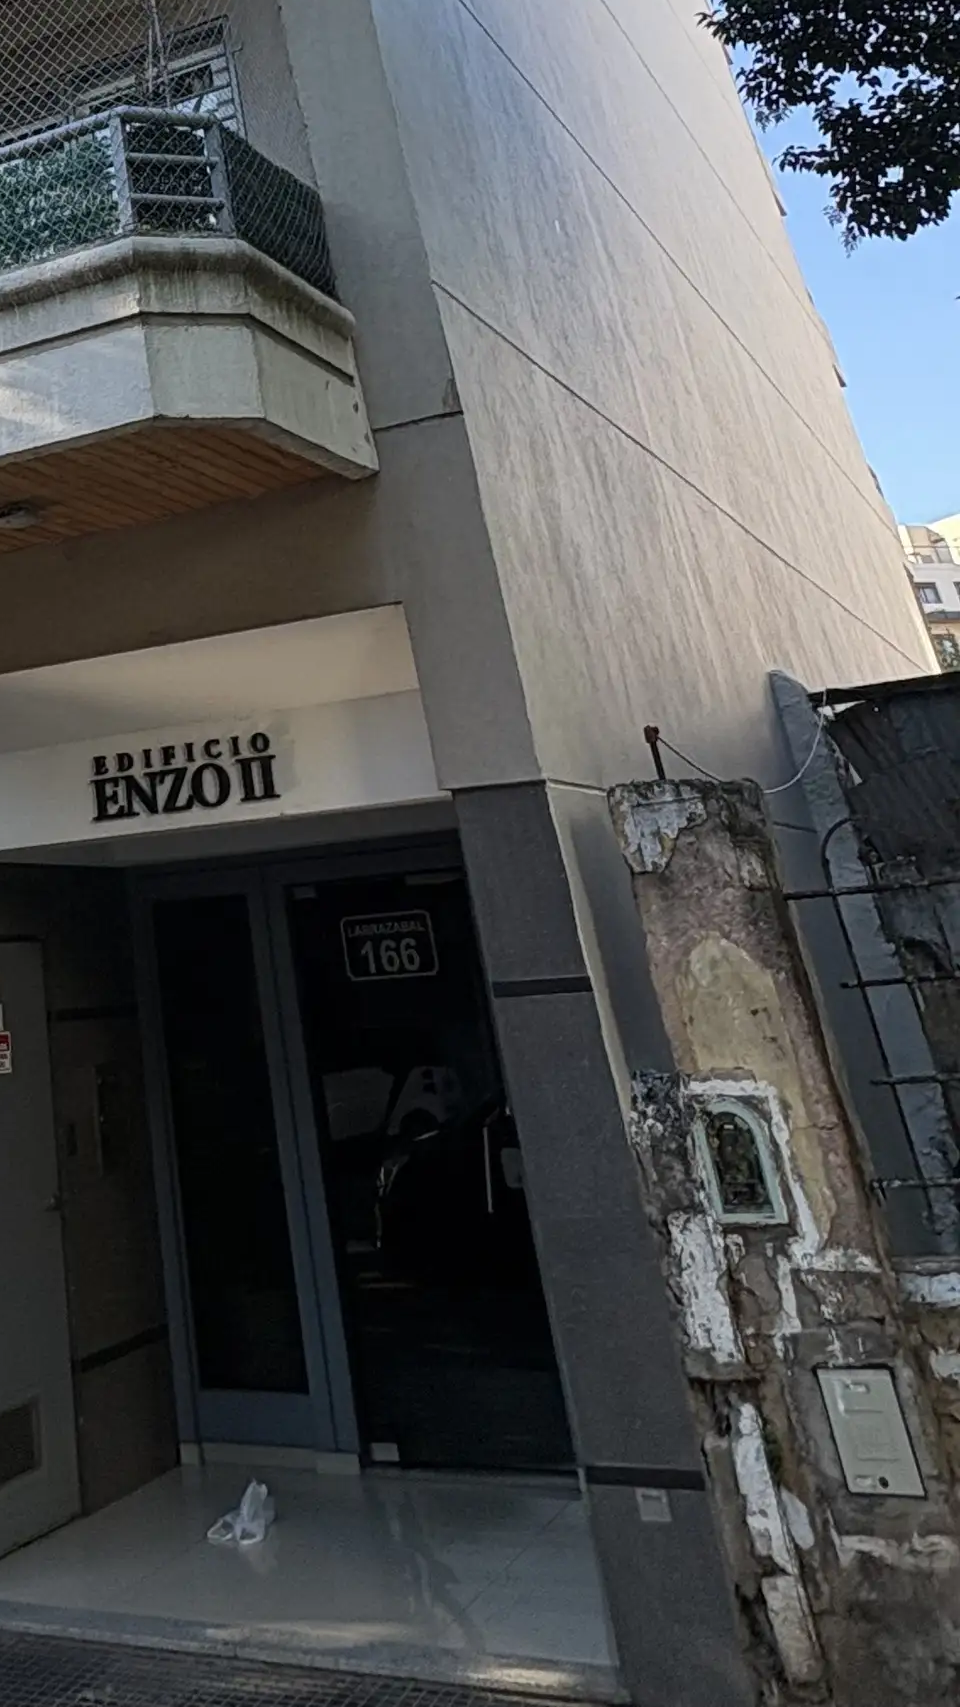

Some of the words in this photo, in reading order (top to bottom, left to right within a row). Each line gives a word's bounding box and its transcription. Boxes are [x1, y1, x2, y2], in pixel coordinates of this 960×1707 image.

[93, 732, 270, 776] EDIFICIO
[90, 762, 231, 821] ENZO
[235, 754, 281, 802] II
[360, 937, 420, 974] 166
